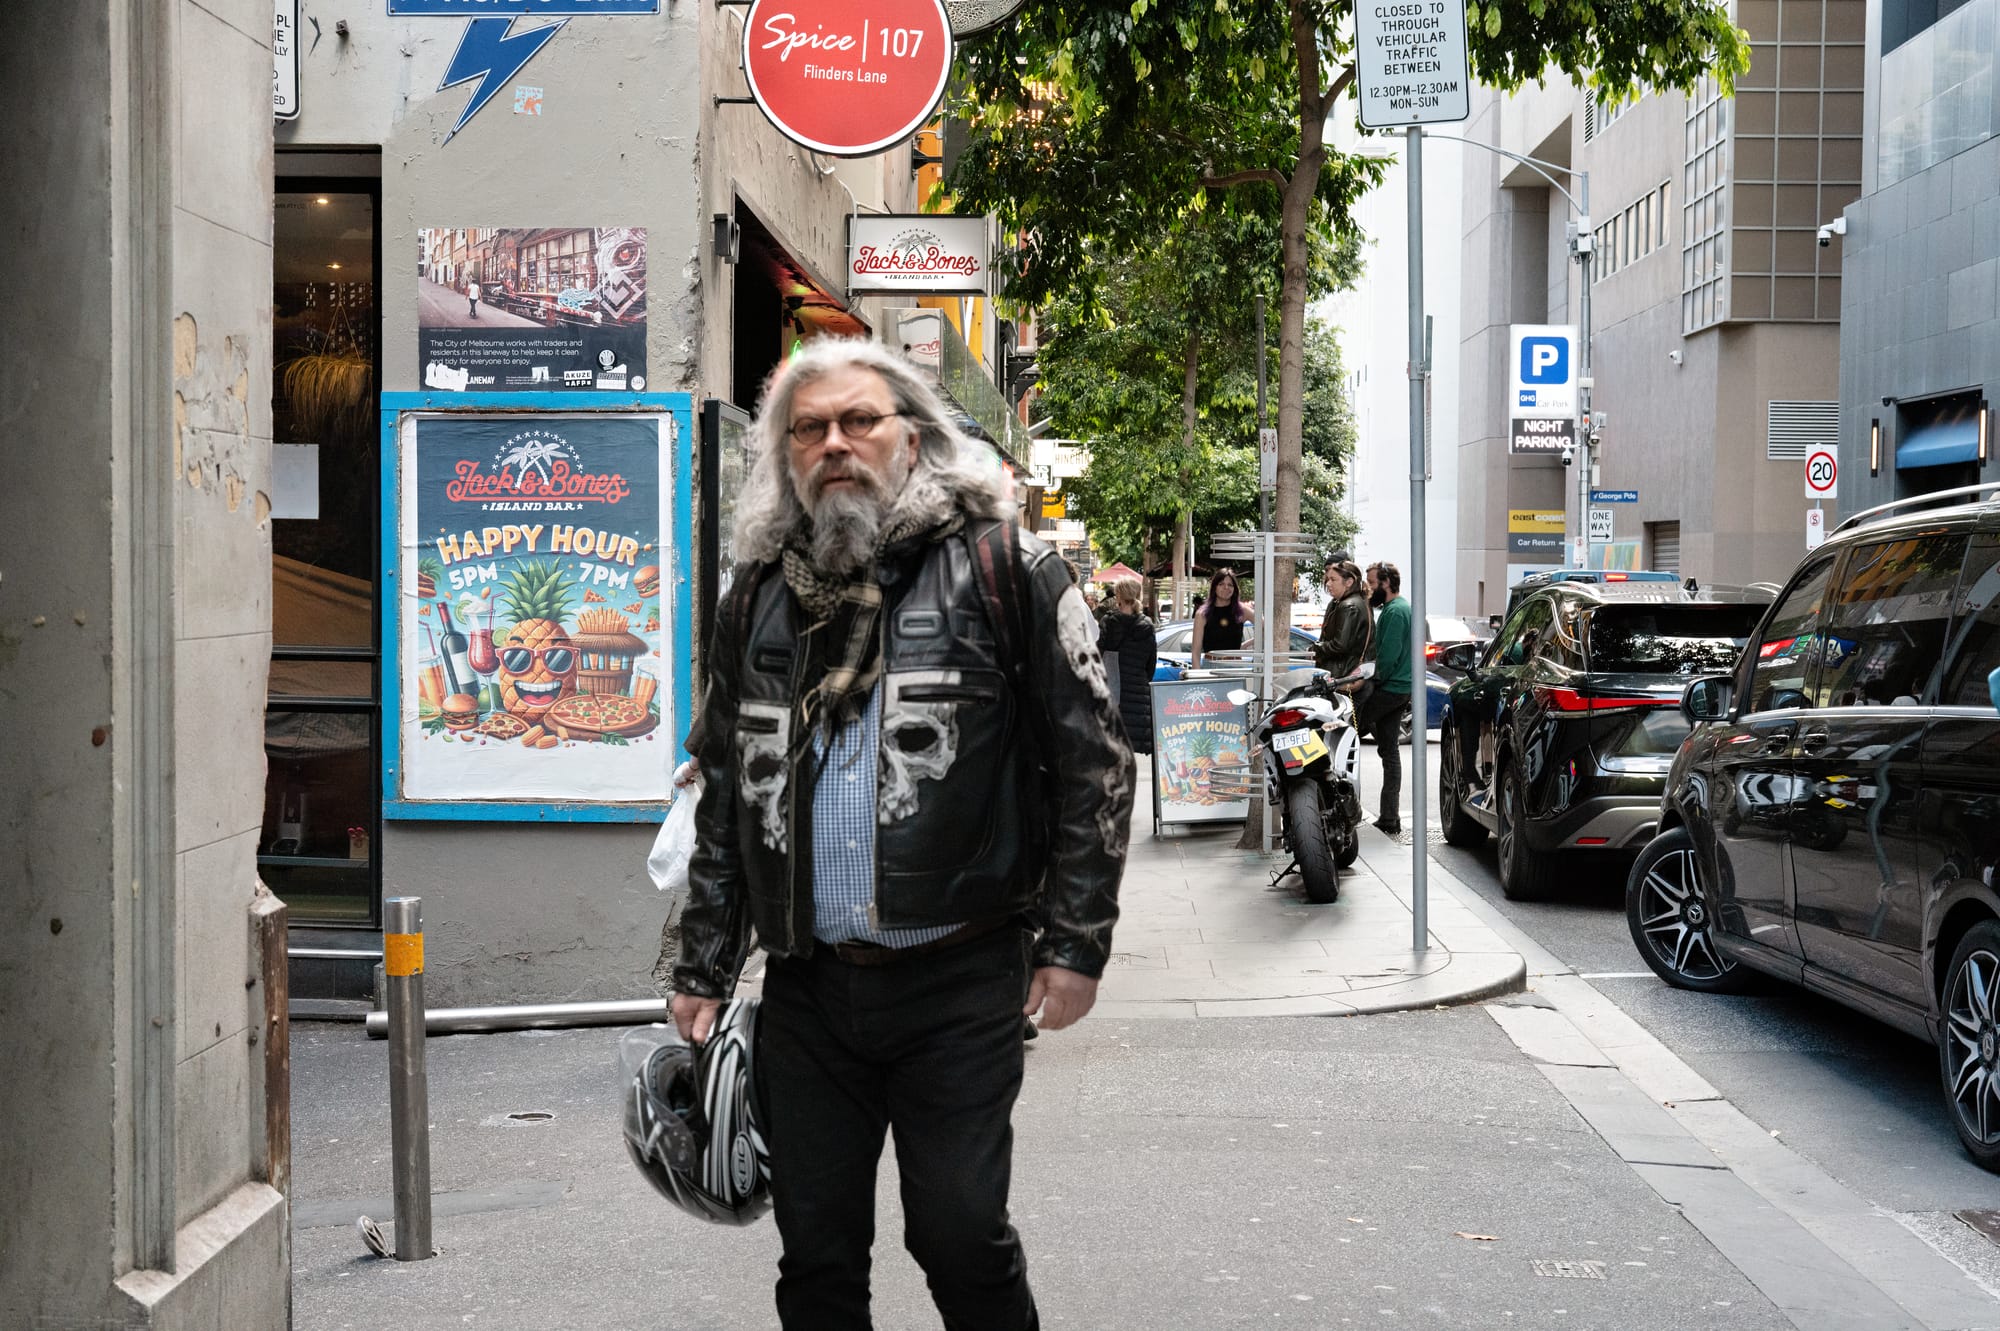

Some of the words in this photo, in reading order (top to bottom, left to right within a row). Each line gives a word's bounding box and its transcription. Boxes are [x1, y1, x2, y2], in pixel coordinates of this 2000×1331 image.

[1375, 4, 1422, 18] CLOSED
[1429, 2, 1444, 14] TO
[1382, 17, 1439, 32] THROUGH
[762, 13, 856, 62] Spice
[880, 27, 924, 58] 107
[1376, 31, 1447, 47] VEHICULAR
[1386, 46, 1438, 60] TRAFFIC
[804, 64, 854, 82] Flinders
[857, 68, 887, 84] Lane
[1384, 60, 1441, 75] BETWEEN
[1390, 96, 1439, 110] MON-SUN
[853, 246, 904, 275] Jack
[919, 246, 980, 276] Bones
[444, 340, 459, 348] City
[482, 349, 510, 357] laneway
[520, 349, 535, 357] help
[537, 349, 554, 357] keep
[1532, 344, 1559, 376] P
[445, 358, 458, 366] tidy
[512, 358, 531, 366] enjoy.
[1523, 420, 1564, 433] NIGHT
[1515, 436, 1572, 448] PARKING
[1812, 462, 1832, 481] 20
[446, 459, 520, 502] Jack
[538, 459, 631, 504] Bones
[489, 502, 543, 511] ISLAND
[544, 502, 576, 511] BAR
[1592, 512, 1610, 520] ONE
[1591, 522, 1611, 531] WAY
[436, 524, 544, 566] HAPPY
[550, 524, 639, 567] HOUR
[1517, 538, 1530, 546] Car
[1532, 538, 1556, 546] Return
[448, 561, 498, 591] 5PM
[579, 562, 630, 591] 7PM
[1161, 720, 1204, 738] HAPPY
[1205, 720, 1241, 736] HOUR
[1167, 735, 1187, 749] 5PM
[1217, 734, 1238, 745] 7PM
